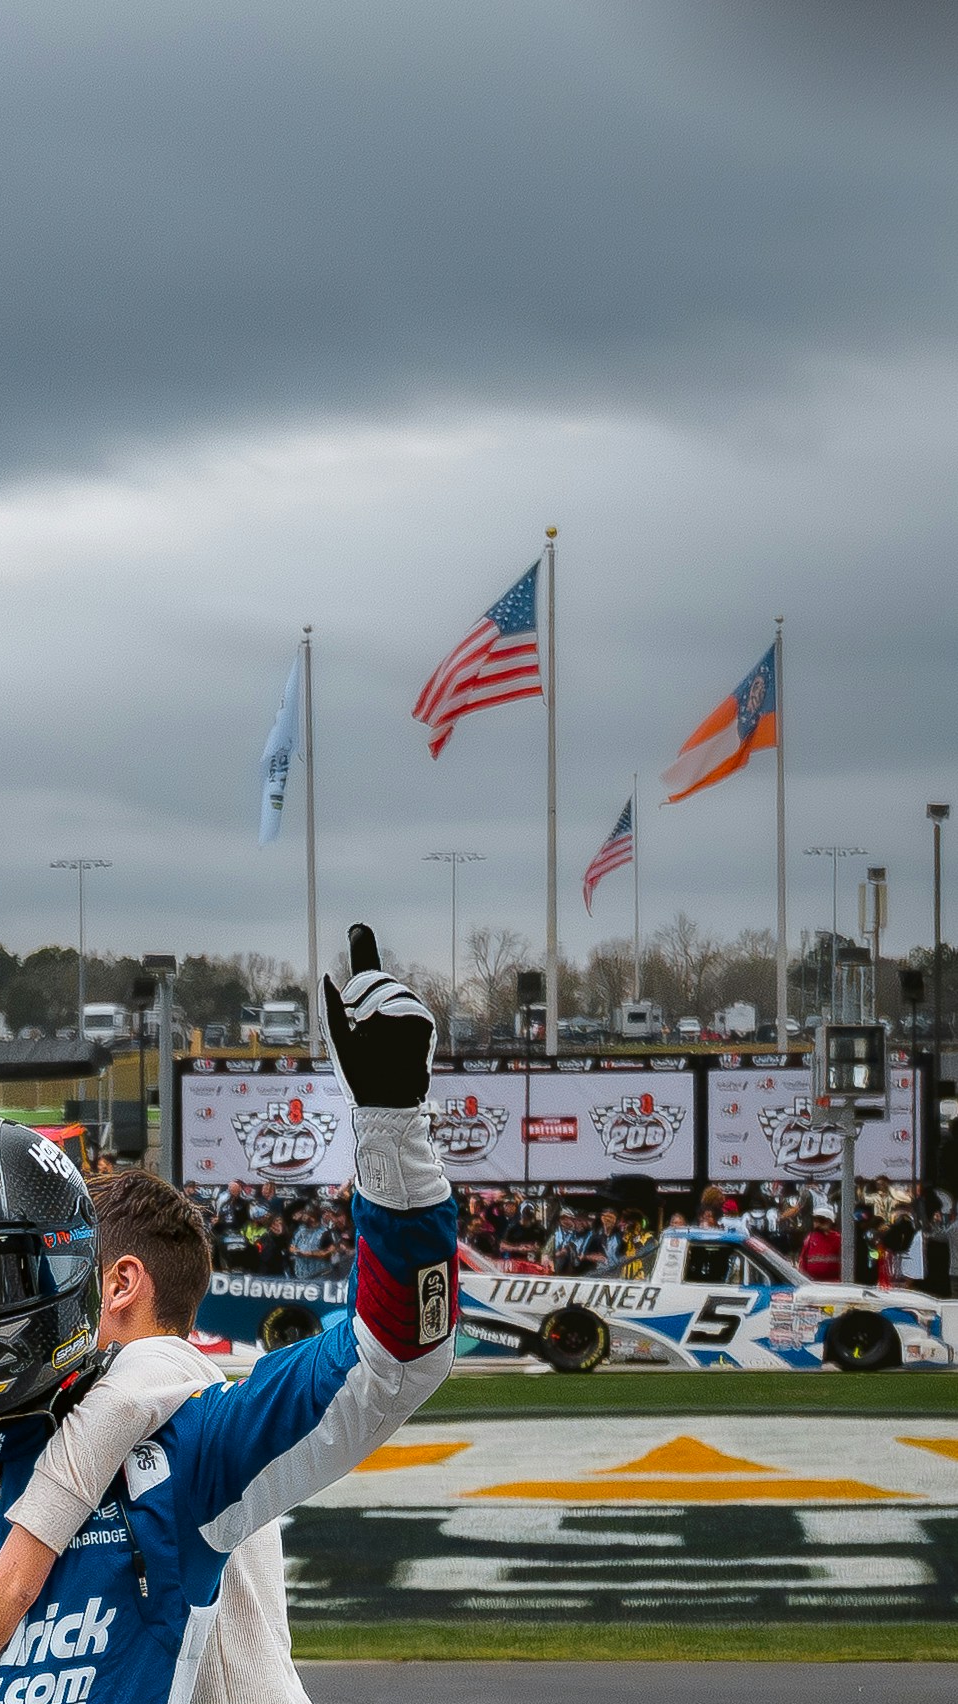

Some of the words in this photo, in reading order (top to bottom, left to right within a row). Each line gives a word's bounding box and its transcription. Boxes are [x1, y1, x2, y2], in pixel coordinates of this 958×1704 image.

[211, 1274, 319, 1301] Delaware
[490, 1278, 551, 1305] TOP
[566, 1282, 663, 1311] LINER
[686, 1294, 753, 1345] 5
